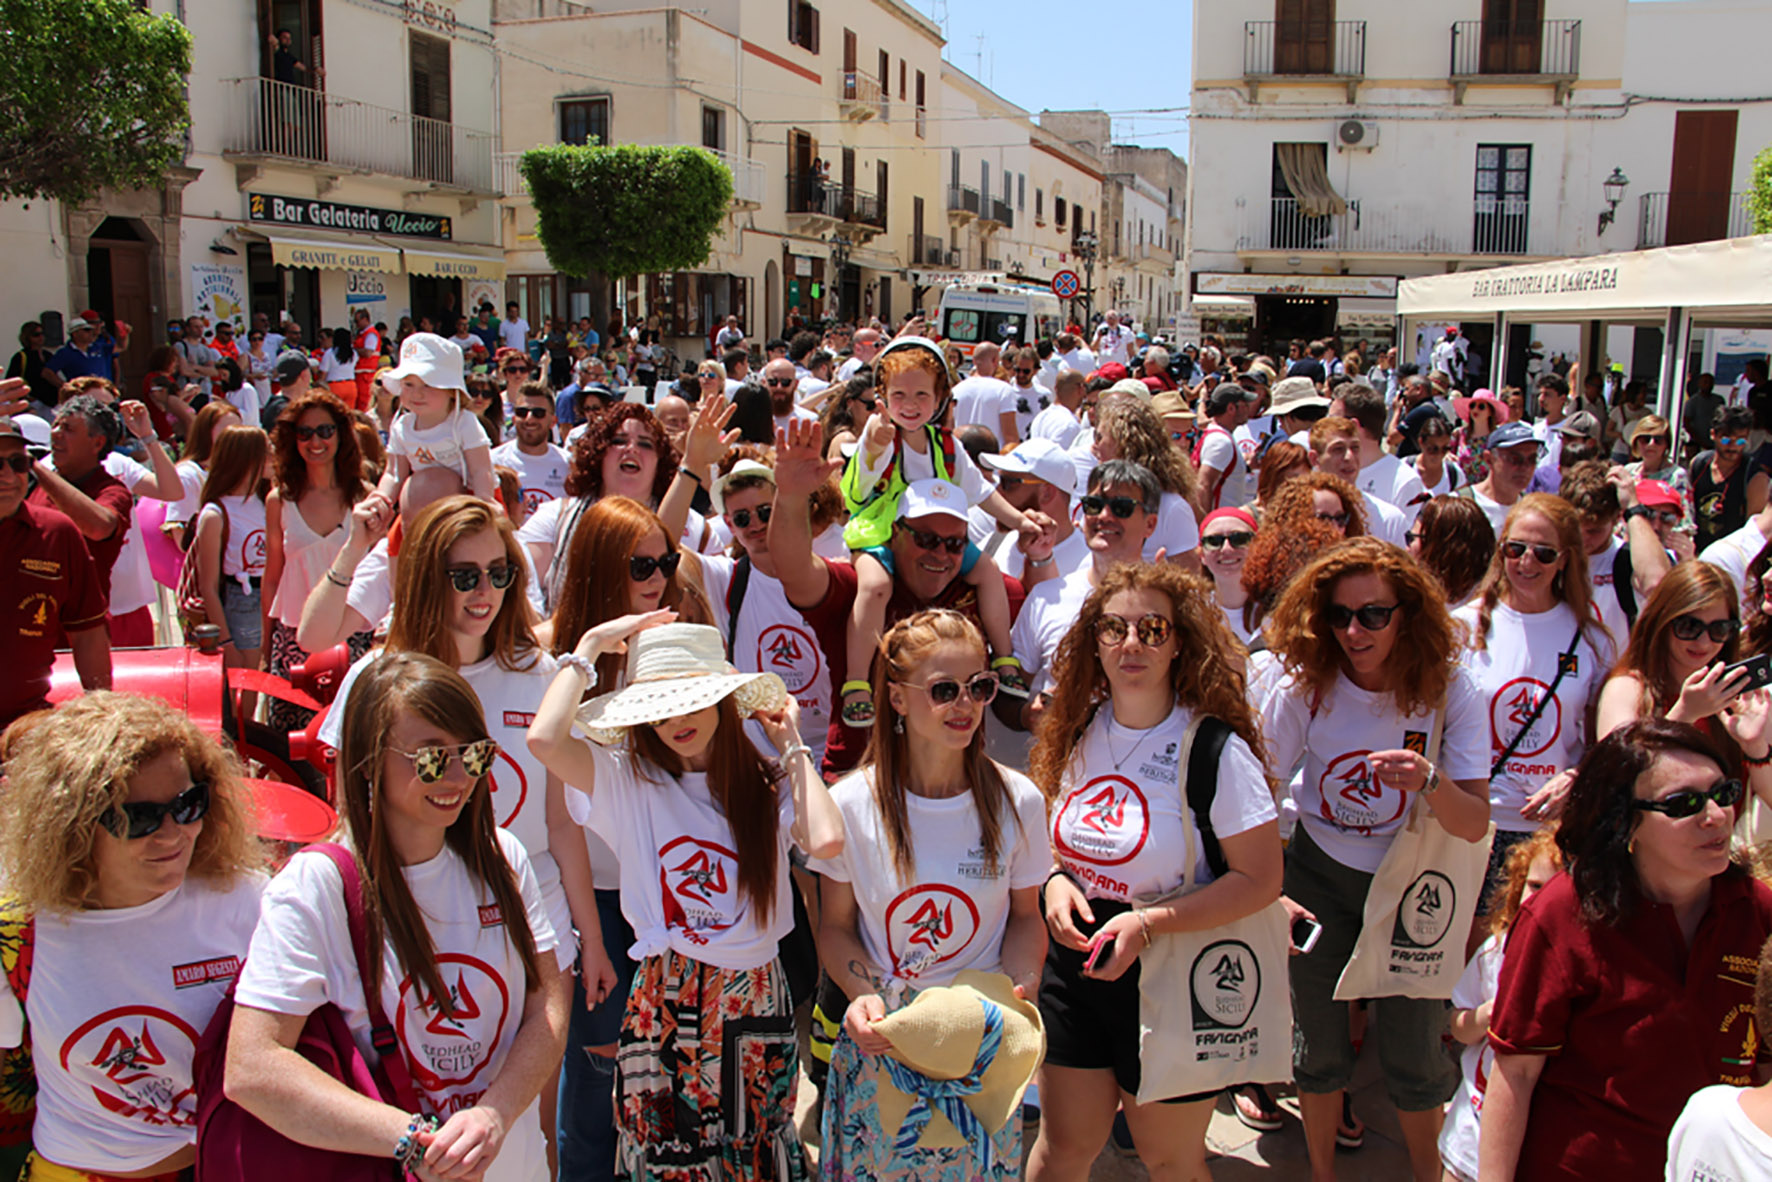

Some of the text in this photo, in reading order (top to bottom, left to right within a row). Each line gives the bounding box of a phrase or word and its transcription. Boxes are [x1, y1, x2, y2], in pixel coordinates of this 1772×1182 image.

[273, 198, 439, 233] Bar Gelateria Uccio
[292, 250, 380, 268] GRANITE e GELATI
[435, 262, 452, 273] BAR
[1472, 268, 1618, 297] BAR TRATTORIA LA LAMPARA
[1491, 755, 1557, 776] FIGNANA
[176, 964, 206, 984] AMARO
[1196, 1027, 1258, 1046] FAVIGNANA
[430, 1048, 482, 1073] ICILY
